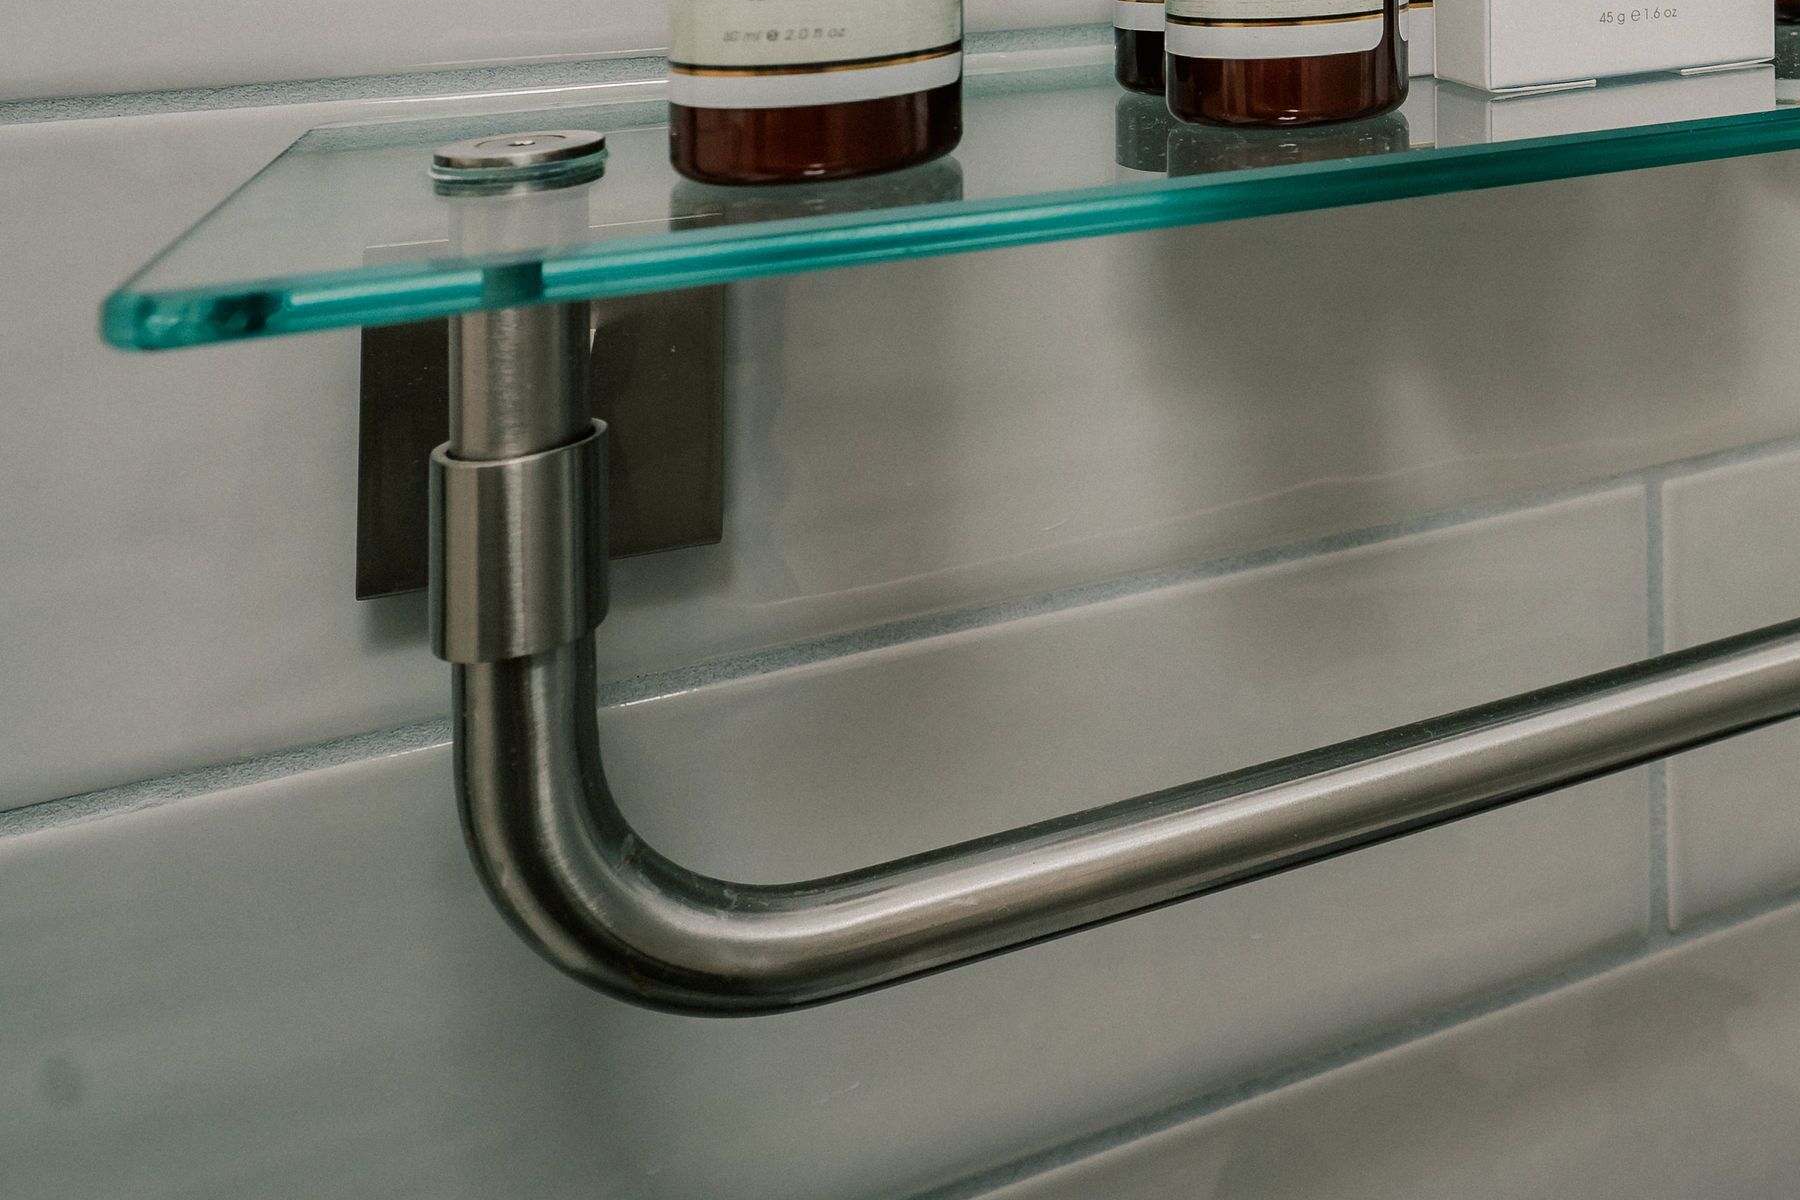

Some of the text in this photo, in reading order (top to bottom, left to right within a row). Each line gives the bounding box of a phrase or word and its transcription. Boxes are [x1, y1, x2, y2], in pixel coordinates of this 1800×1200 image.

[1599, 11, 1614, 24] 45
[1617, 12, 1626, 25] g
[1644, 7, 1661, 20] 1.6
[1663, 8, 1678, 18] oz
